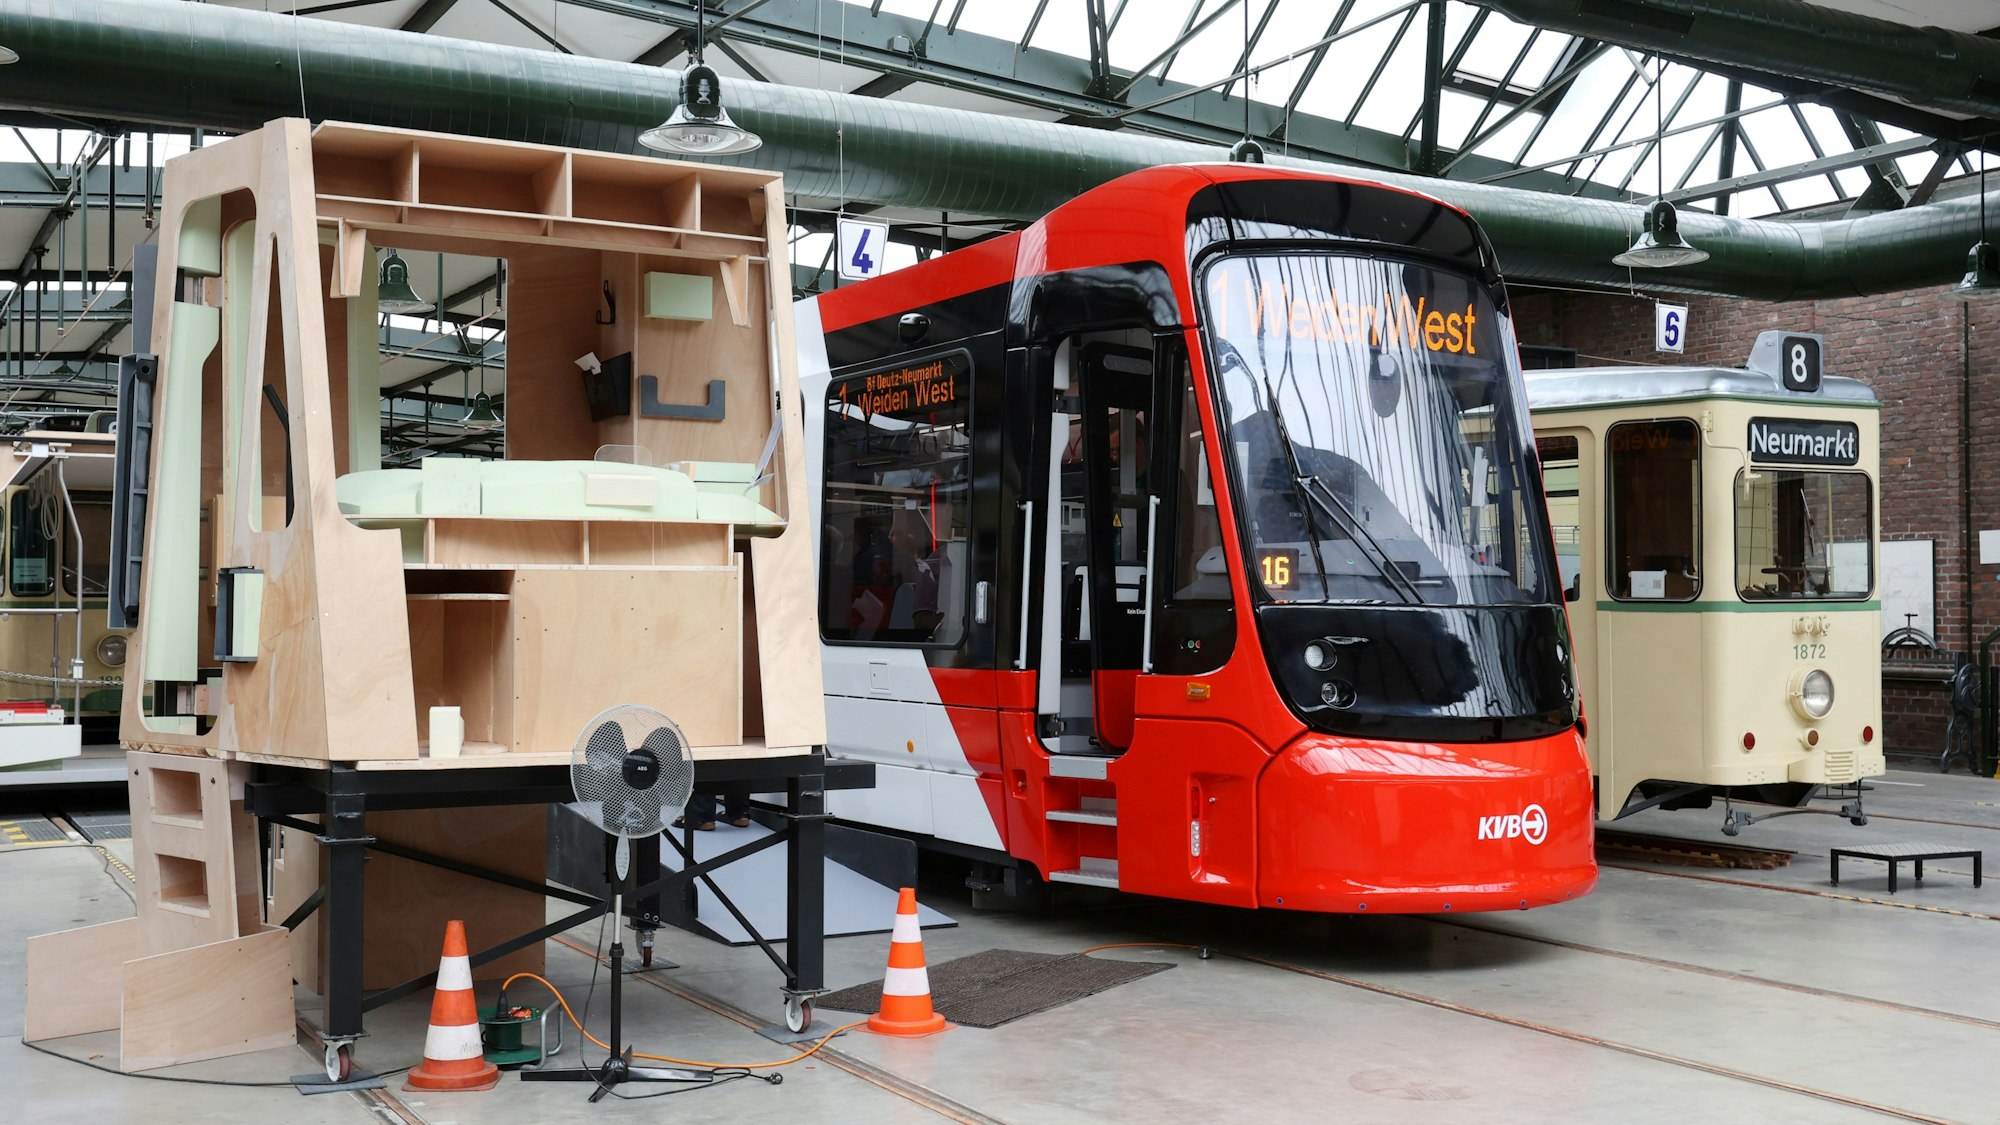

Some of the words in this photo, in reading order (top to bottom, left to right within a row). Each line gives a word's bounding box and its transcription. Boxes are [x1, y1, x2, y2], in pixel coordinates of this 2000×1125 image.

[851, 229, 873, 274] 4
[1211, 268, 1231, 339] 1
[1244, 279, 1379, 346] Weiden
[1384, 292, 1476, 354] West
[1664, 311, 1680, 347] 6
[867, 376, 876, 392] Bf
[877, 361, 943, 388] Deutz-Neumarkt
[1790, 343, 1808, 384] 8
[839, 382, 849, 421] 1
[857, 389, 908, 417] Weiden
[914, 374, 955, 407] West
[1751, 424, 1855, 459] Neumarkt
[1262, 556, 1290, 585] 16
[1793, 643, 1826, 660] 1872
[1478, 815, 1521, 840] KVB
